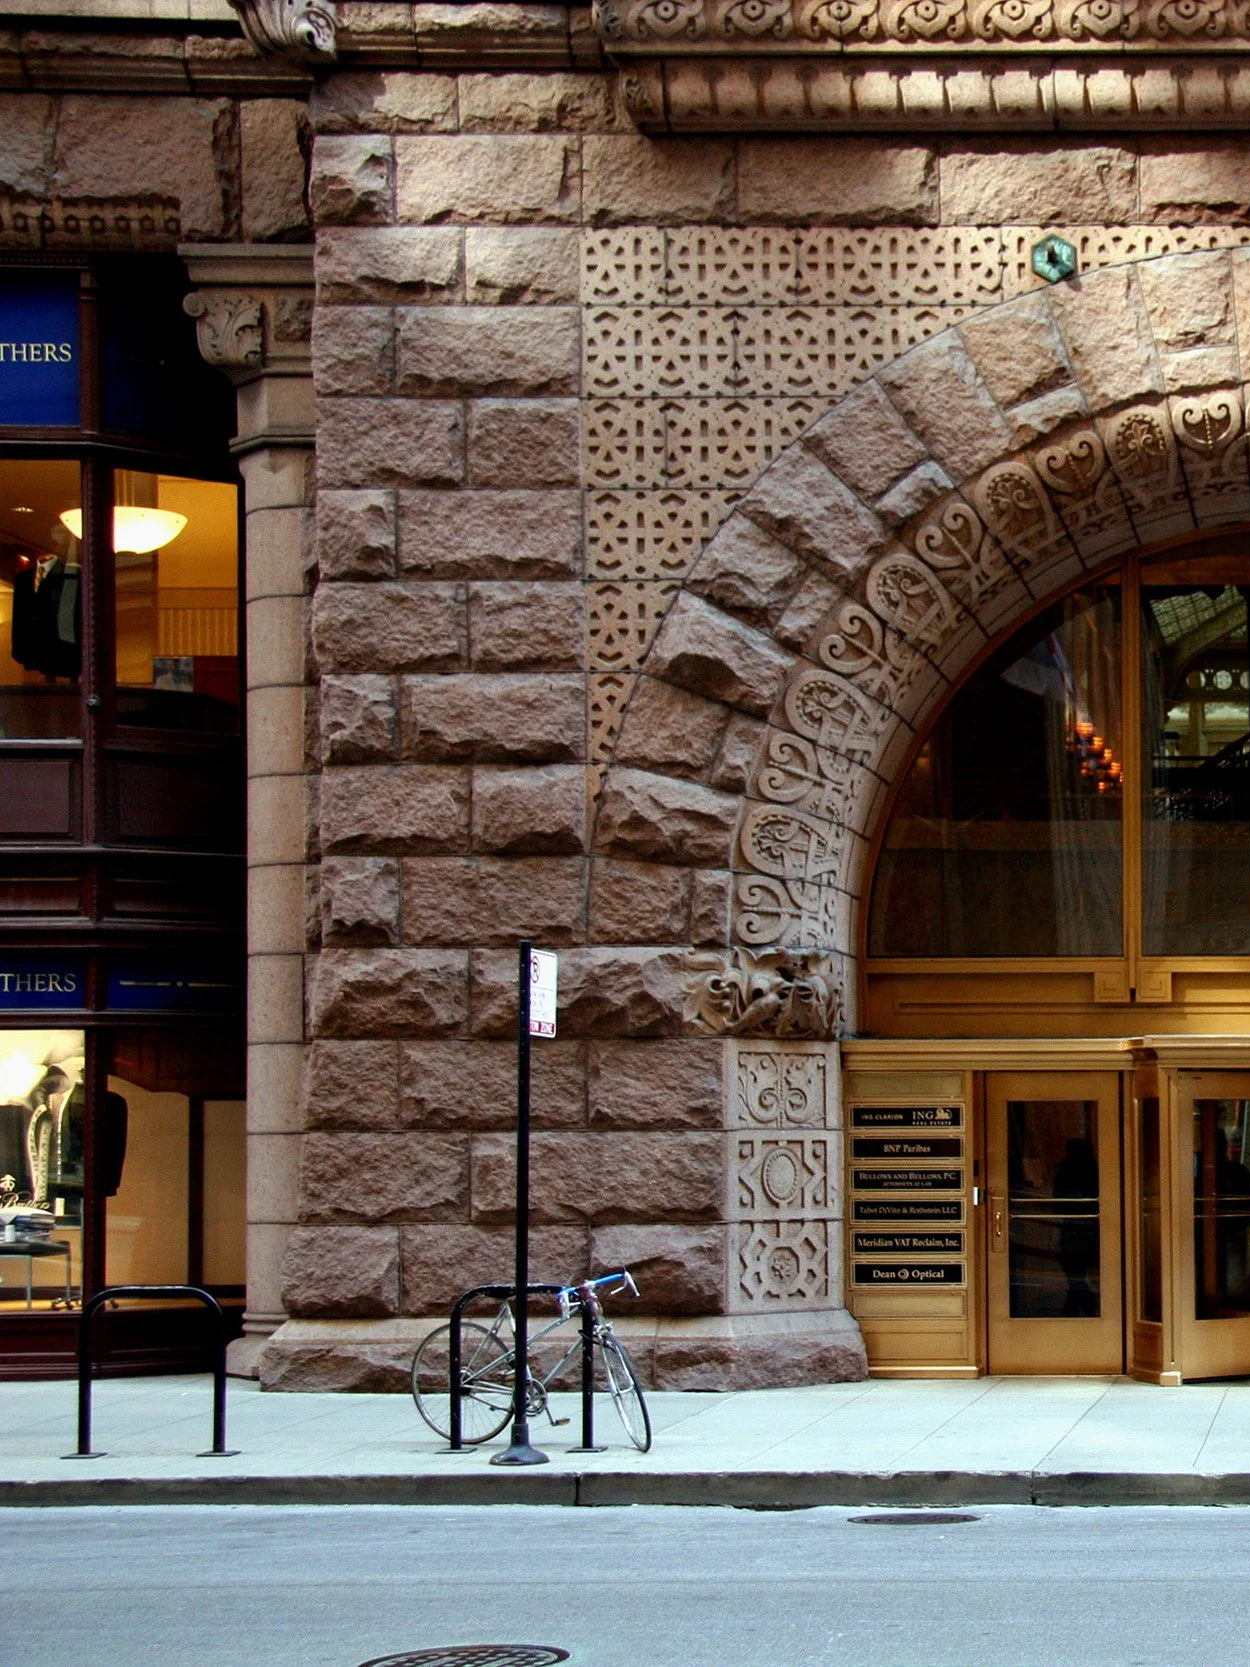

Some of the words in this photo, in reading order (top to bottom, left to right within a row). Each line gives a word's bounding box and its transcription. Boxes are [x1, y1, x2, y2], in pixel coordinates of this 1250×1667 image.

[0, 973, 77, 992] THERS
[912, 1110, 934, 1120] ING
[883, 1144, 902, 1153] BNP
[903, 1144, 931, 1153] Paribas
[942, 1206, 958, 1214] LLC
[857, 1237, 894, 1247] Meridian
[894, 1238, 911, 1247] VAT
[912, 1238, 944, 1248] Reclaim,
[945, 1237, 960, 1247] Inc.
[872, 1269, 896, 1279] Dean
[911, 1269, 945, 1281] Optical
